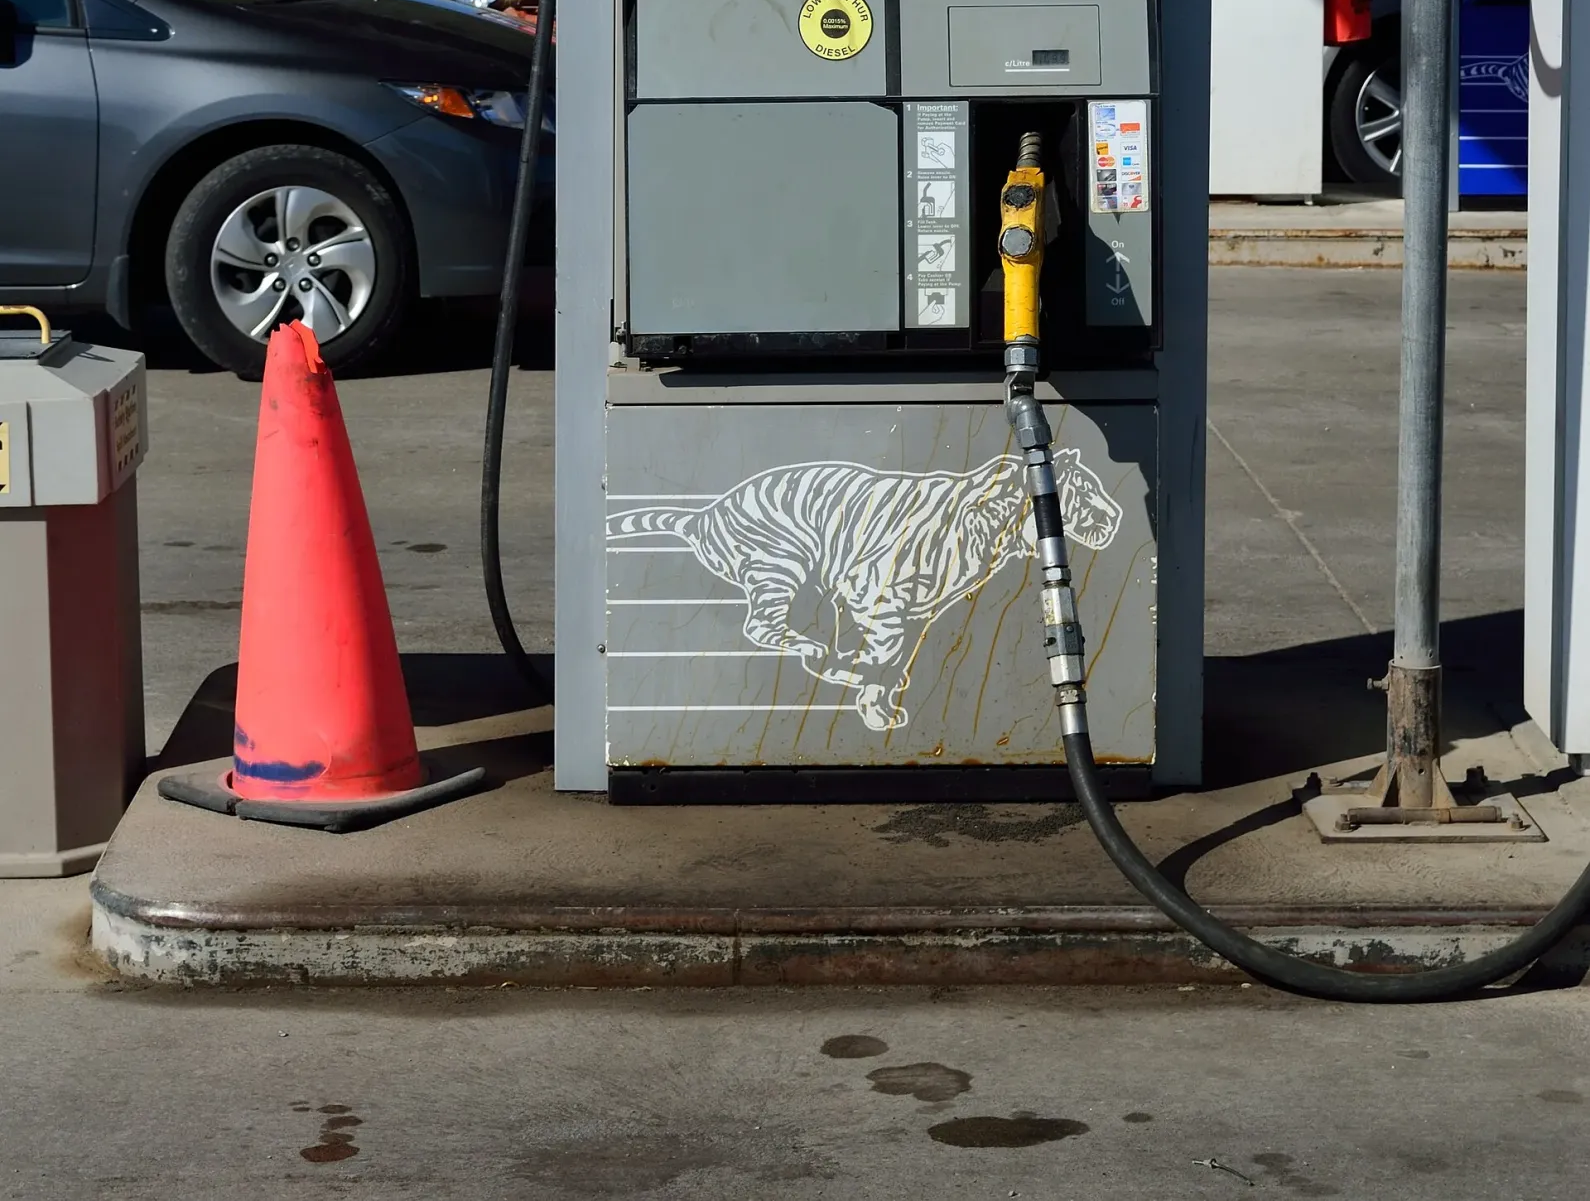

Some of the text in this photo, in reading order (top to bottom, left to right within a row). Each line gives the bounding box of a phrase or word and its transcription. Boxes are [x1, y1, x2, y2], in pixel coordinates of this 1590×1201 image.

[815, 44, 855, 57] DIESEL
[917, 104, 958, 112] Important:
[1111, 240, 1125, 248] On
[1111, 297, 1125, 306] Off
